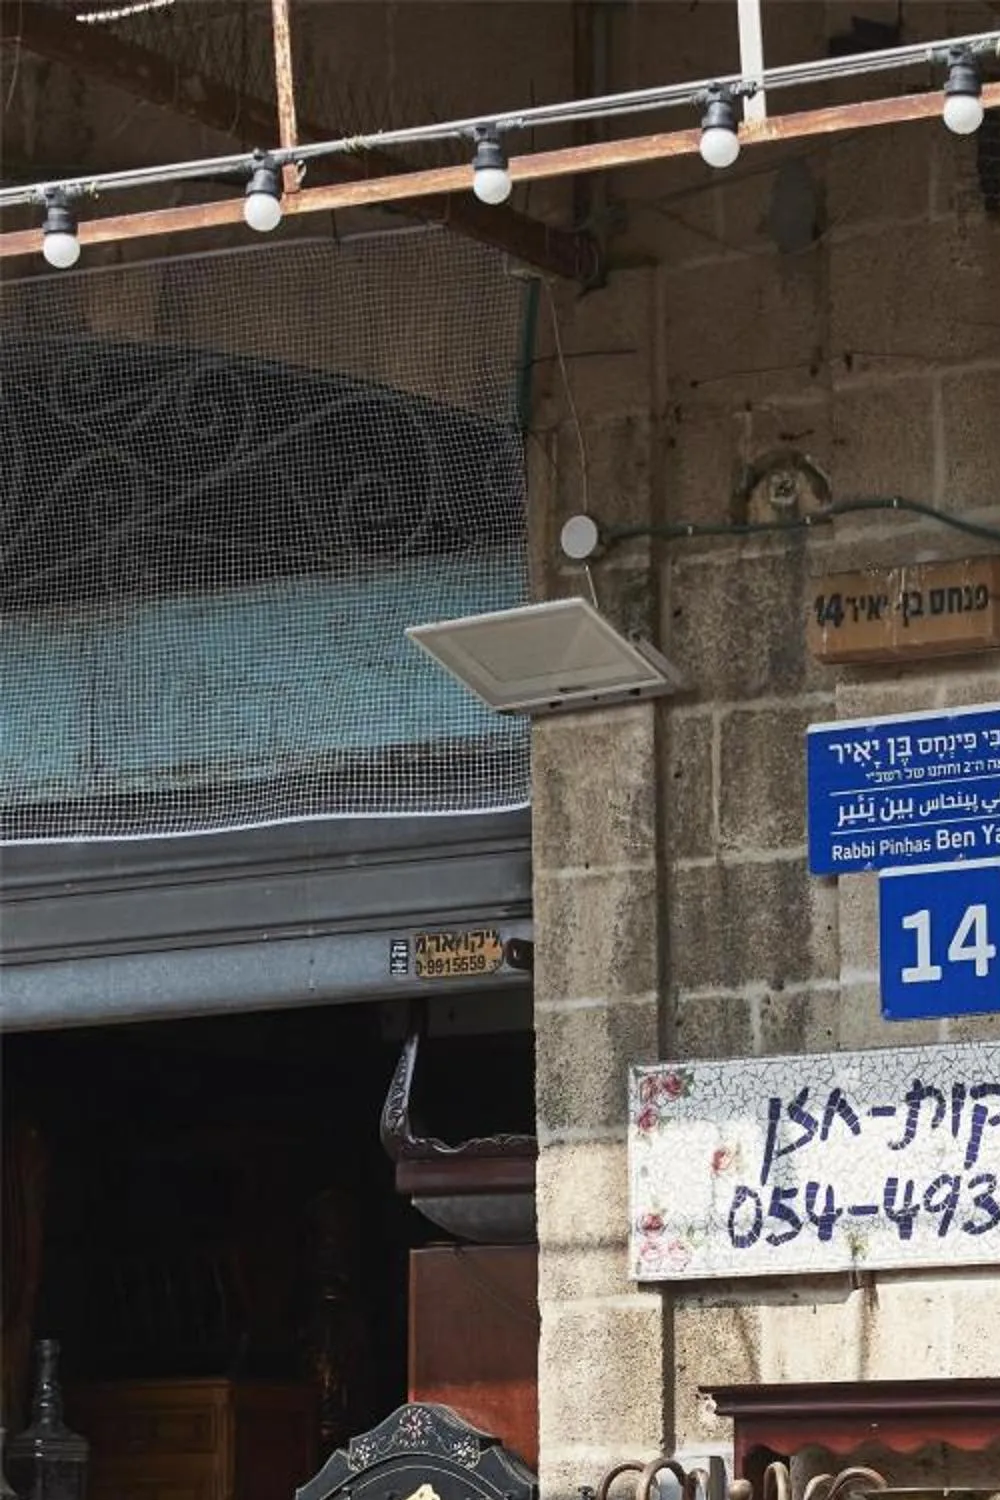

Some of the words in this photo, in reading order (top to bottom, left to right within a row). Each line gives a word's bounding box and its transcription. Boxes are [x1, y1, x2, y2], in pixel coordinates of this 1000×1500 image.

[929, 583, 989, 615] פנחס
[903, 767, 925, 780] של
[831, 841, 876, 861] Rabbi
[936, 829, 976, 850] Ben
[901, 903, 997, 983] 14
